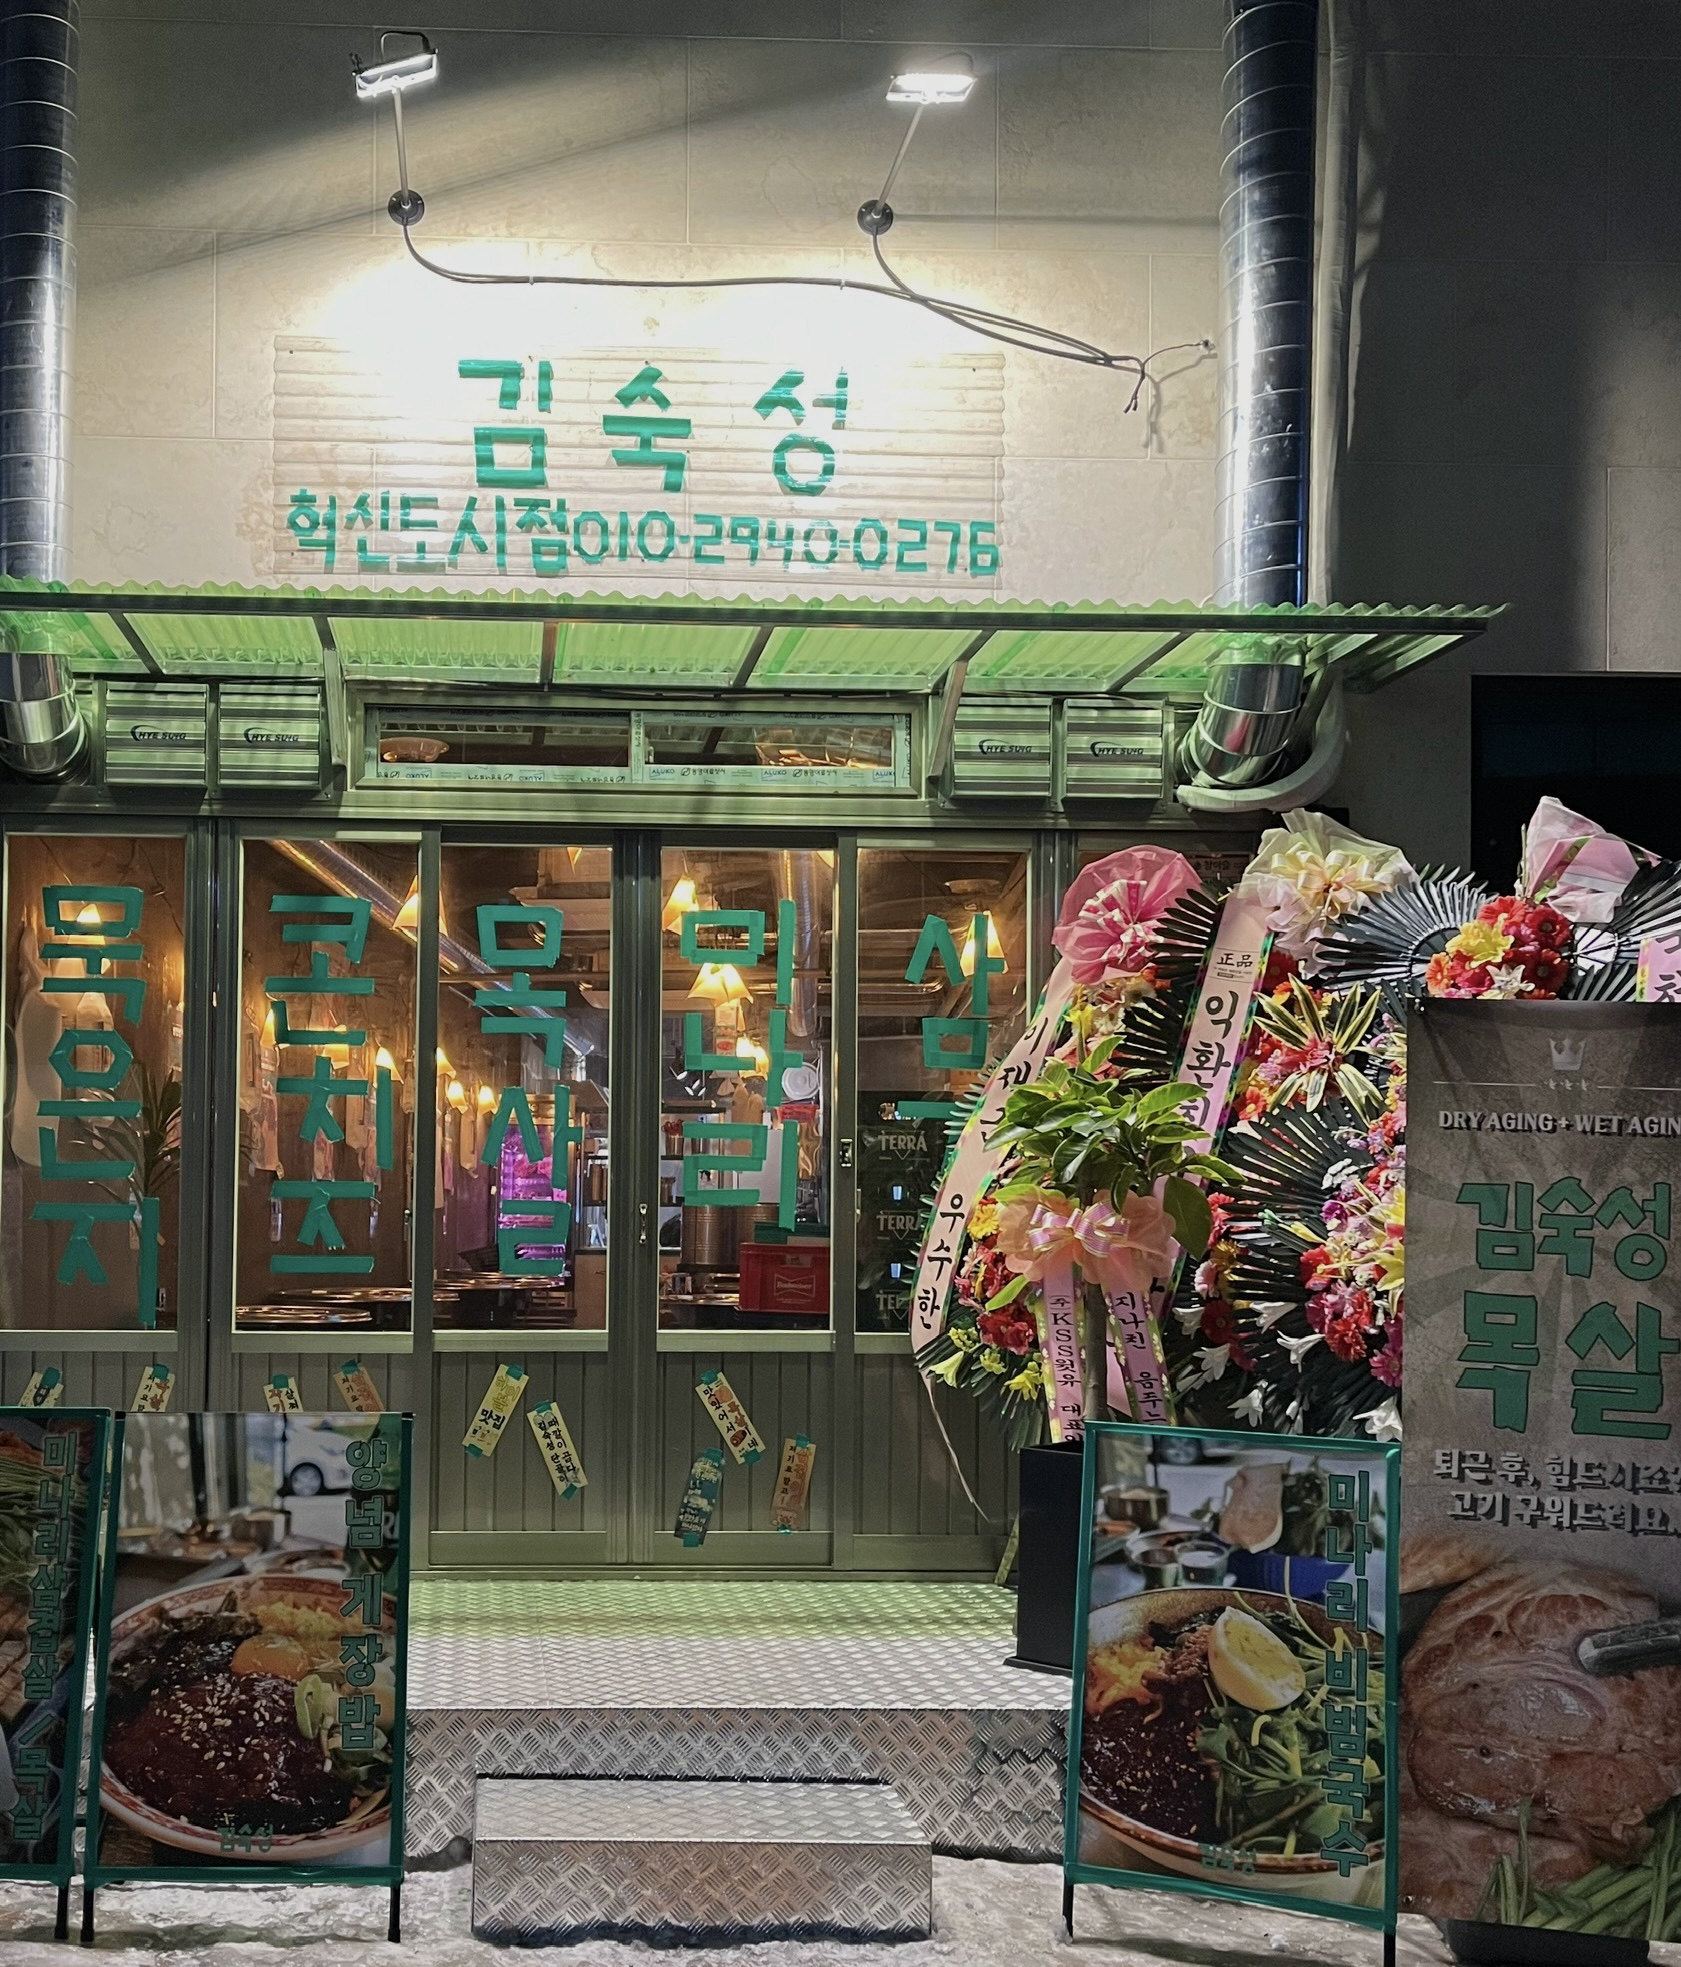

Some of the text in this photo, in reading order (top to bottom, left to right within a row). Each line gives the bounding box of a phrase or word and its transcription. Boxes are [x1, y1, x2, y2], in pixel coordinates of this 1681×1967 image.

[457, 358, 849, 497] 김숙성
[287, 487, 1001, 578] 혁신도시점 010-2940-0276
[1216, 952, 1254, 968] 正品
[31, 884, 159, 1330] 묵은지
[264, 894, 393, 1275] 콘치즈
[474, 903, 584, 1277] 목살
[681, 899, 804, 1232] 미나리
[877, 1133, 928, 1152] TERRA
[1438, 1109, 1485, 1130] DRY
[1485, 1111, 1556, 1133] AGING
[1574, 1113, 1624, 1134] WET
[1455, 1176, 1671, 1282] 김숙성
[1111, 1291, 1147, 1350] 지나친
[1455, 1289, 1681, 1441] 목살
[479, 1408, 506, 1431] 맛집
[1433, 1449, 1491, 1482] 퇴근
[1497, 1451, 1538, 1488] 후,
[345, 1438, 389, 1551] 양념
[1447, 1491, 1509, 1524] 고기
[337, 1572, 384, 1752] 게장밥
[1319, 1469, 1373, 1879] 미나리 비빔국수
[217, 1822, 274, 1854] 김숙성
